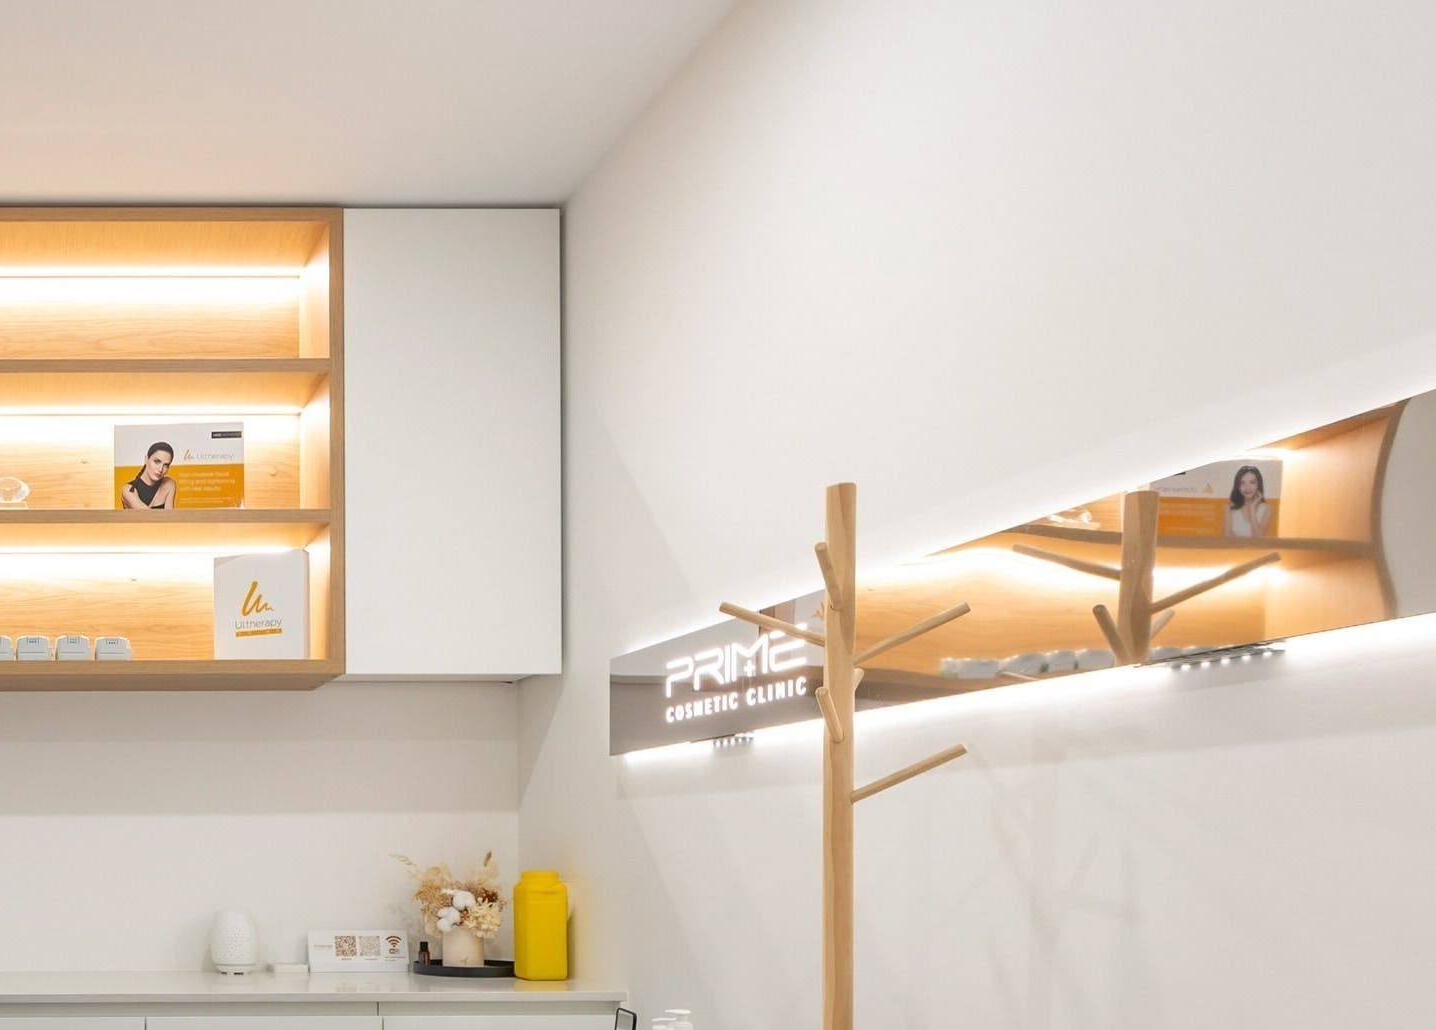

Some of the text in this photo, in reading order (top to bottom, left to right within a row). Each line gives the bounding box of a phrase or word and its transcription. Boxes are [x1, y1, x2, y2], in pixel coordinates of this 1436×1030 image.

[234, 618, 282, 629] Ultherapy
[665, 623, 808, 698] PRIME
[665, 676, 807, 723] COSMETIC CLINIC
